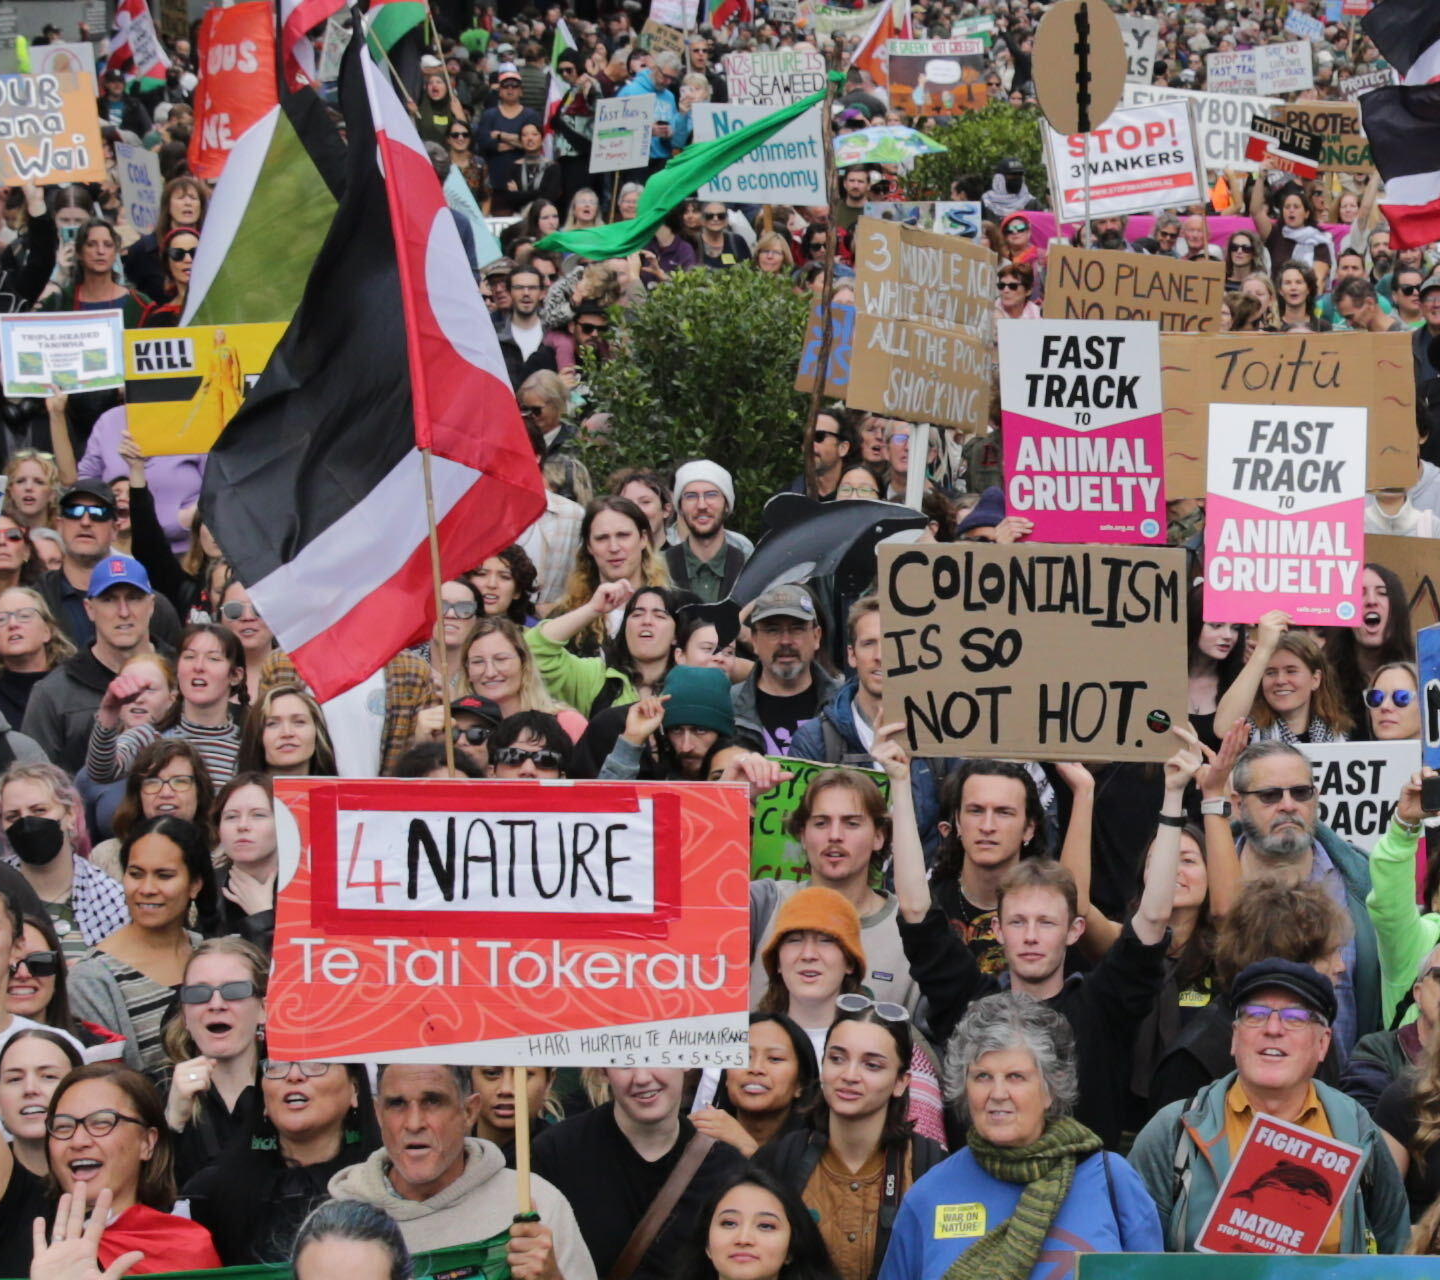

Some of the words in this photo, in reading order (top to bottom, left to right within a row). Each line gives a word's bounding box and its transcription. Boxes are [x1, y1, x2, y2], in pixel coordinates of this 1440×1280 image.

[751, 52, 803, 74] FUTURE
[806, 49, 823, 71] IS
[729, 78, 748, 98] IN
[749, 74, 825, 97] SEAWEED
[1340, 70, 1392, 93] PROTECT
[1068, 119, 1181, 158] STOP!
[7, 142, 90, 178] Wai
[1070, 150, 1184, 178] 3WANKERS
[1060, 255, 1105, 294] NO
[1114, 265, 1221, 304] PLANET
[132, 340, 191, 371] KILL
[1039, 335, 1124, 371] FAST
[1215, 339, 1342, 392] Toitū
[1025, 374, 1139, 410] TRACK
[1074, 411, 1091, 426] TO
[1015, 435, 1152, 474] ANIMAL
[1008, 475, 1160, 514] CRUELTY
[886, 550, 1178, 629] COLONIALISM
[885, 630, 943, 679] IS
[960, 629, 1022, 671] SO
[904, 684, 1012, 751] NOT
[1039, 680, 1149, 749] HOT.
[346, 821, 400, 905] 4
[406, 818, 632, 904] NATURE
[290, 936, 358, 986] Te
[376, 939, 461, 988] Tai
[485, 941, 728, 991] Tokerau
[885, 1174, 896, 1198] EOS
